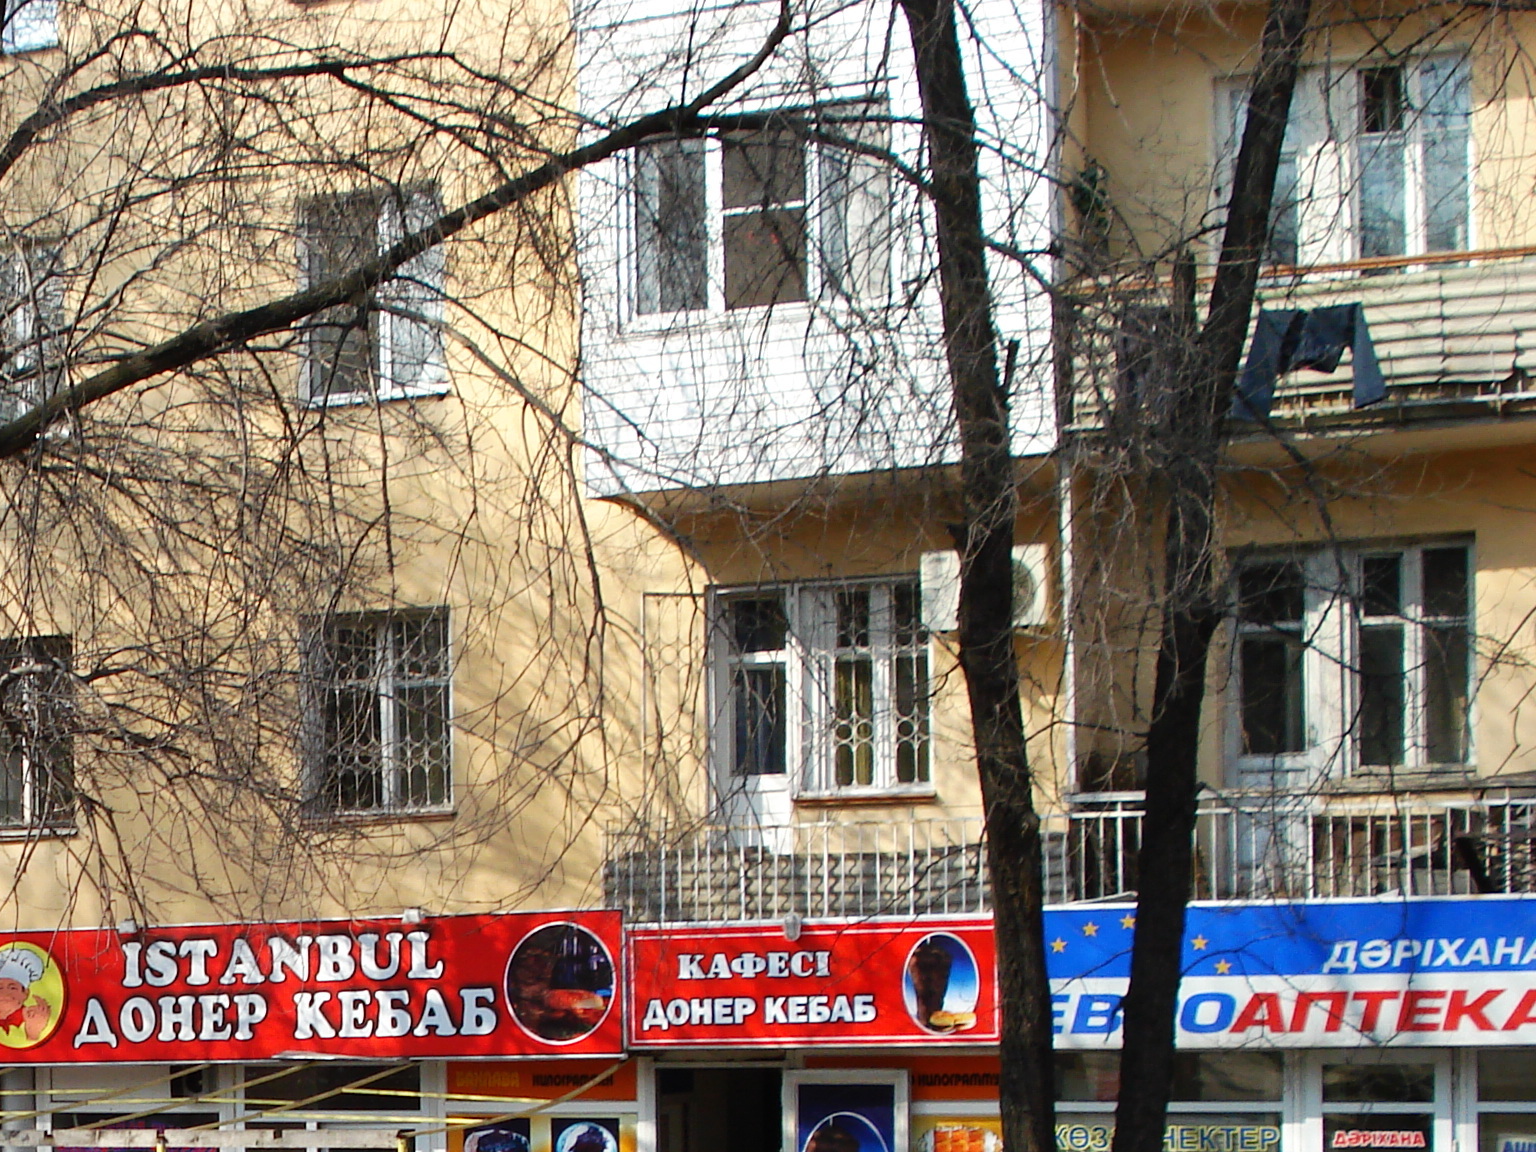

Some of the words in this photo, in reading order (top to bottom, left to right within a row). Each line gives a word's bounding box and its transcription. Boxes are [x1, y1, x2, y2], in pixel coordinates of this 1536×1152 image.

[122, 930, 444, 987] ISTANBUL
[677, 951, 831, 979] КАФЕСІ
[73, 993, 268, 1049] ДОНЕР
[293, 986, 498, 1040] КЕБАБ
[642, 998, 756, 1031] ДОНЕР
[765, 994, 877, 1024] КЕБАБ
[1051, 989, 1536, 1034] ЕВОАПТЕКА
[1333, 1131, 1425, 1147] ДӘРІХАНА
